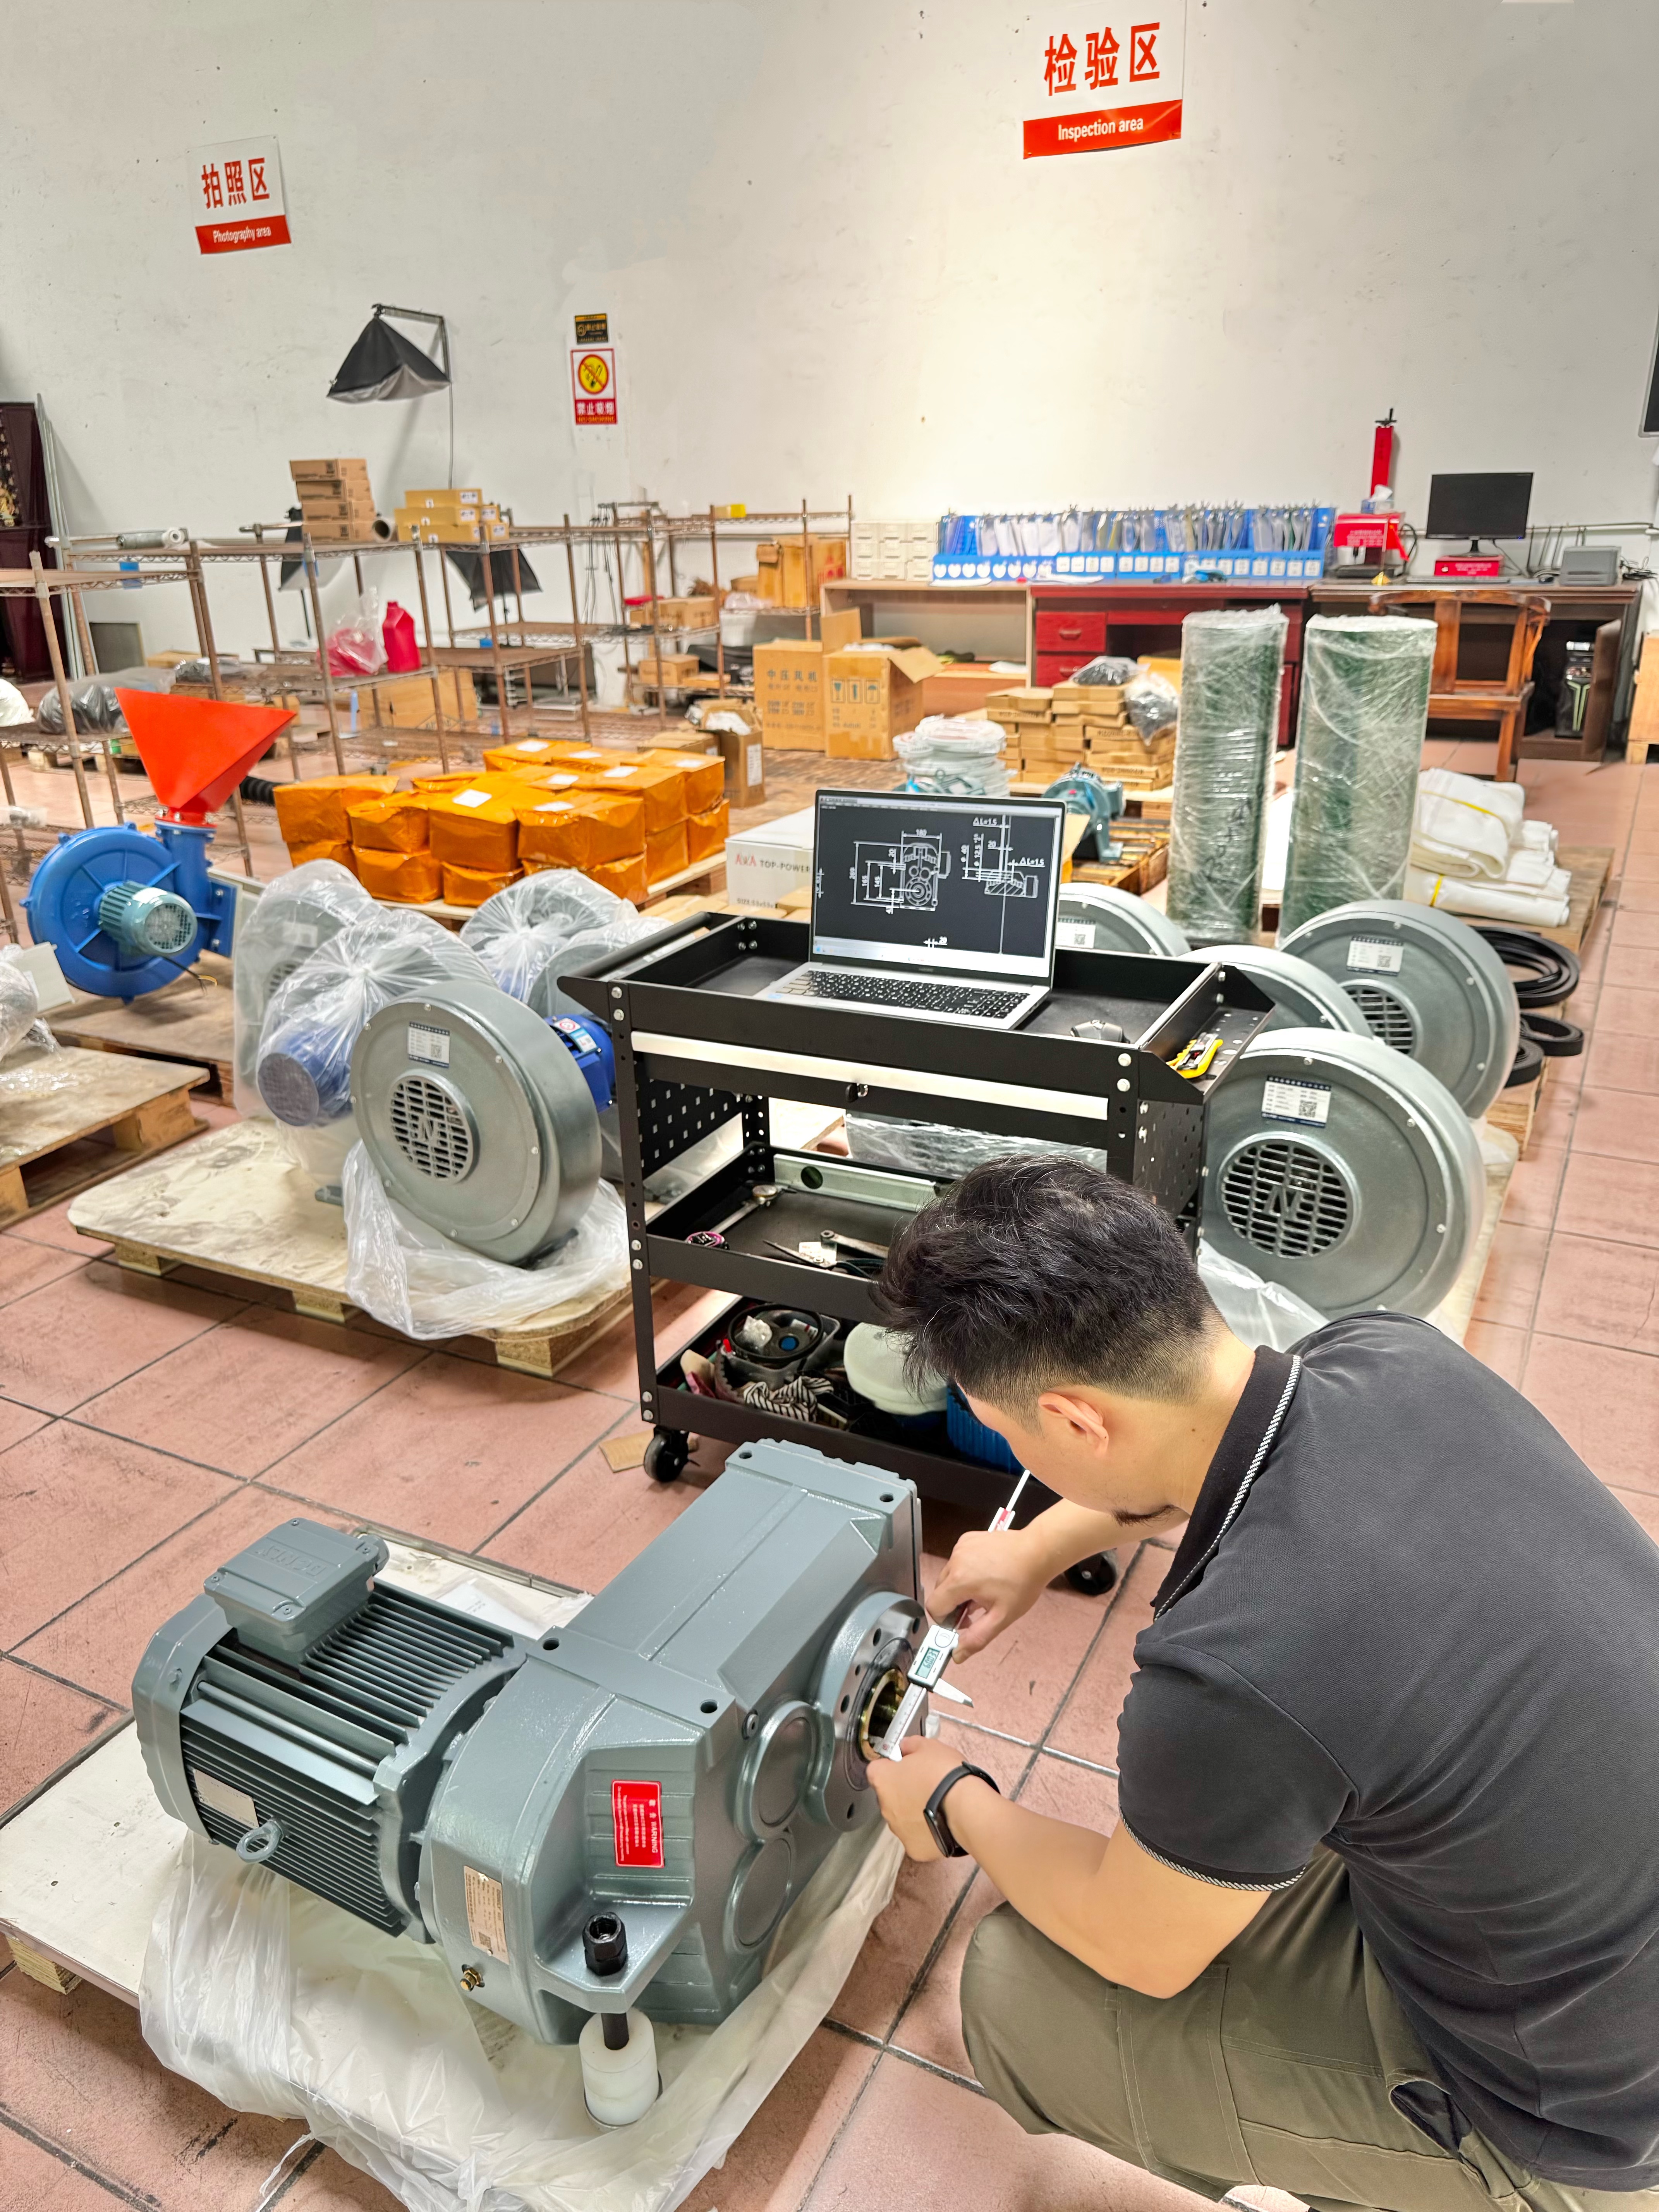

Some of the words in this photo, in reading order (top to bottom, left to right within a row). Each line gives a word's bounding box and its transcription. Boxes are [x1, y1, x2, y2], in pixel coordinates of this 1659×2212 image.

[1044, 22, 1160, 96] 检验区
[1058, 119, 1116, 143] Inspection
[1119, 118, 1144, 132] area
[201, 157, 270, 209] 拍照区
[213, 226, 255, 244] Photography
[256, 227, 271, 237] area
